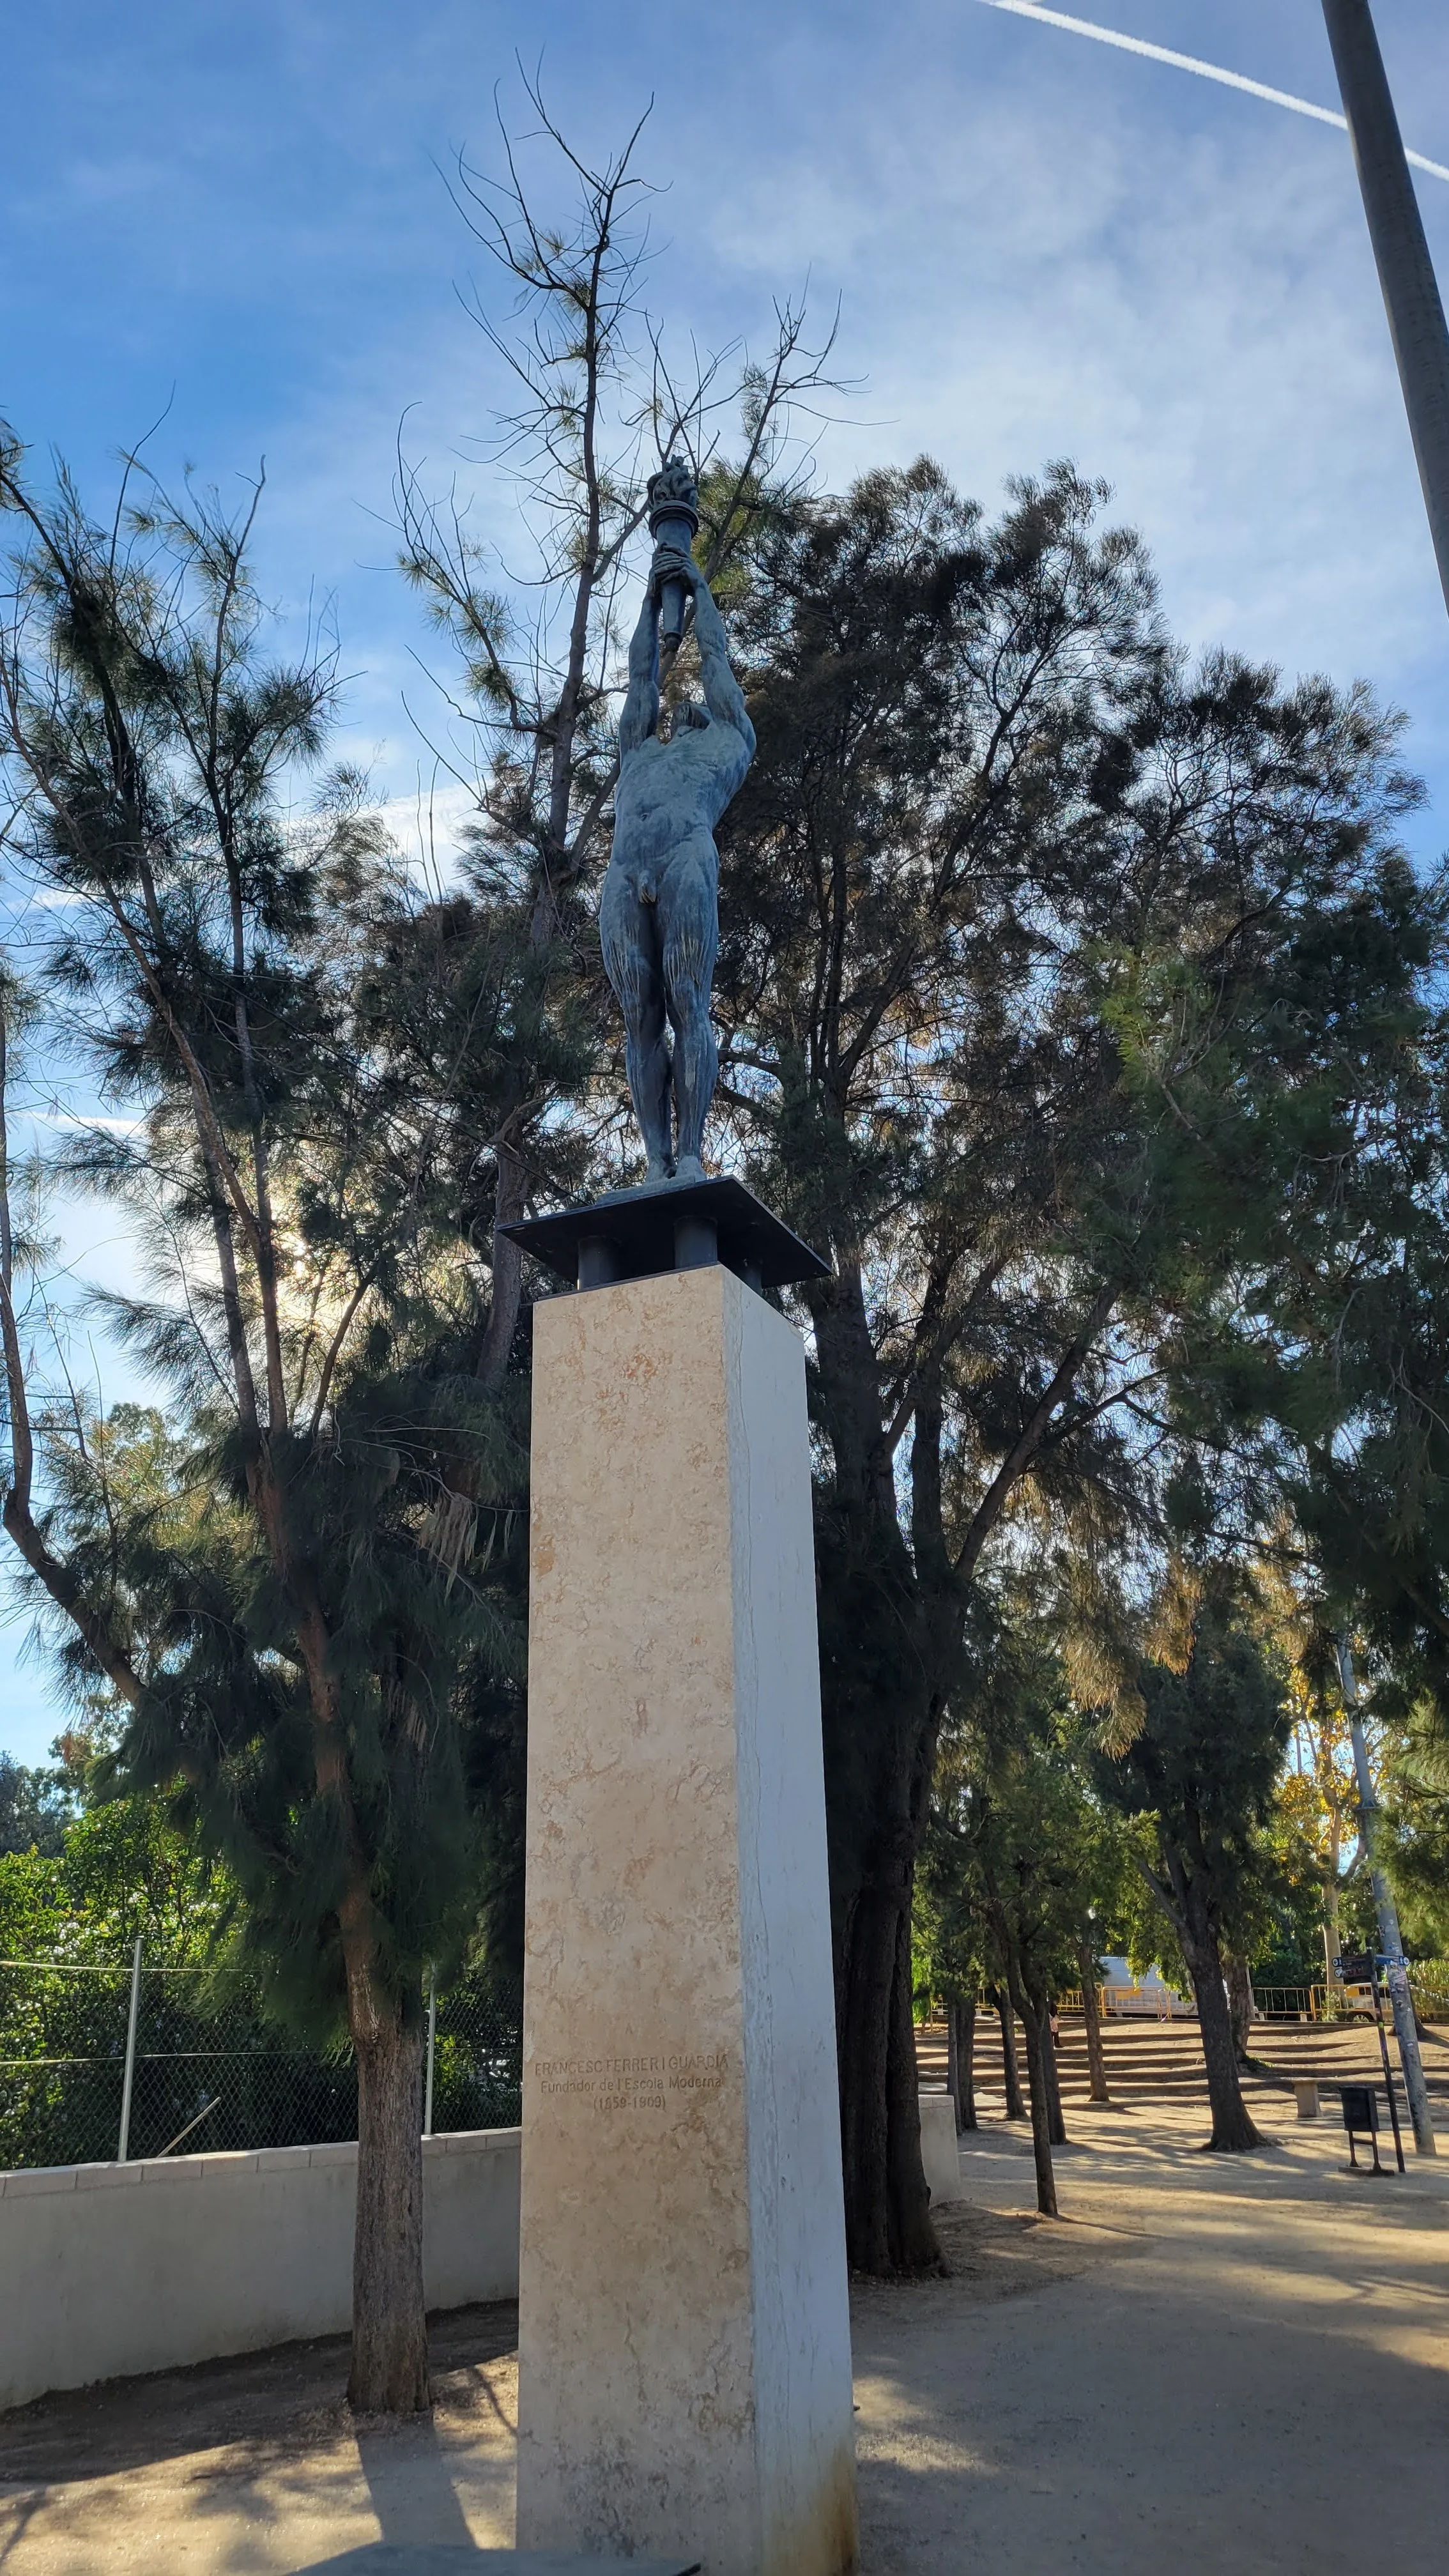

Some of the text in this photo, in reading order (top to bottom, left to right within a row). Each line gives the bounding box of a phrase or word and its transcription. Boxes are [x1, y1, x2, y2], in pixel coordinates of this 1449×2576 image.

[535, 2059, 603, 2076] FRANCESC
[606, 2057, 659, 2073] FERRER
[662, 2056, 665, 2071] I
[541, 2078, 596, 2094] Fundador
[599, 2078, 614, 2091] de
[669, 2074, 722, 2089] Moderna
